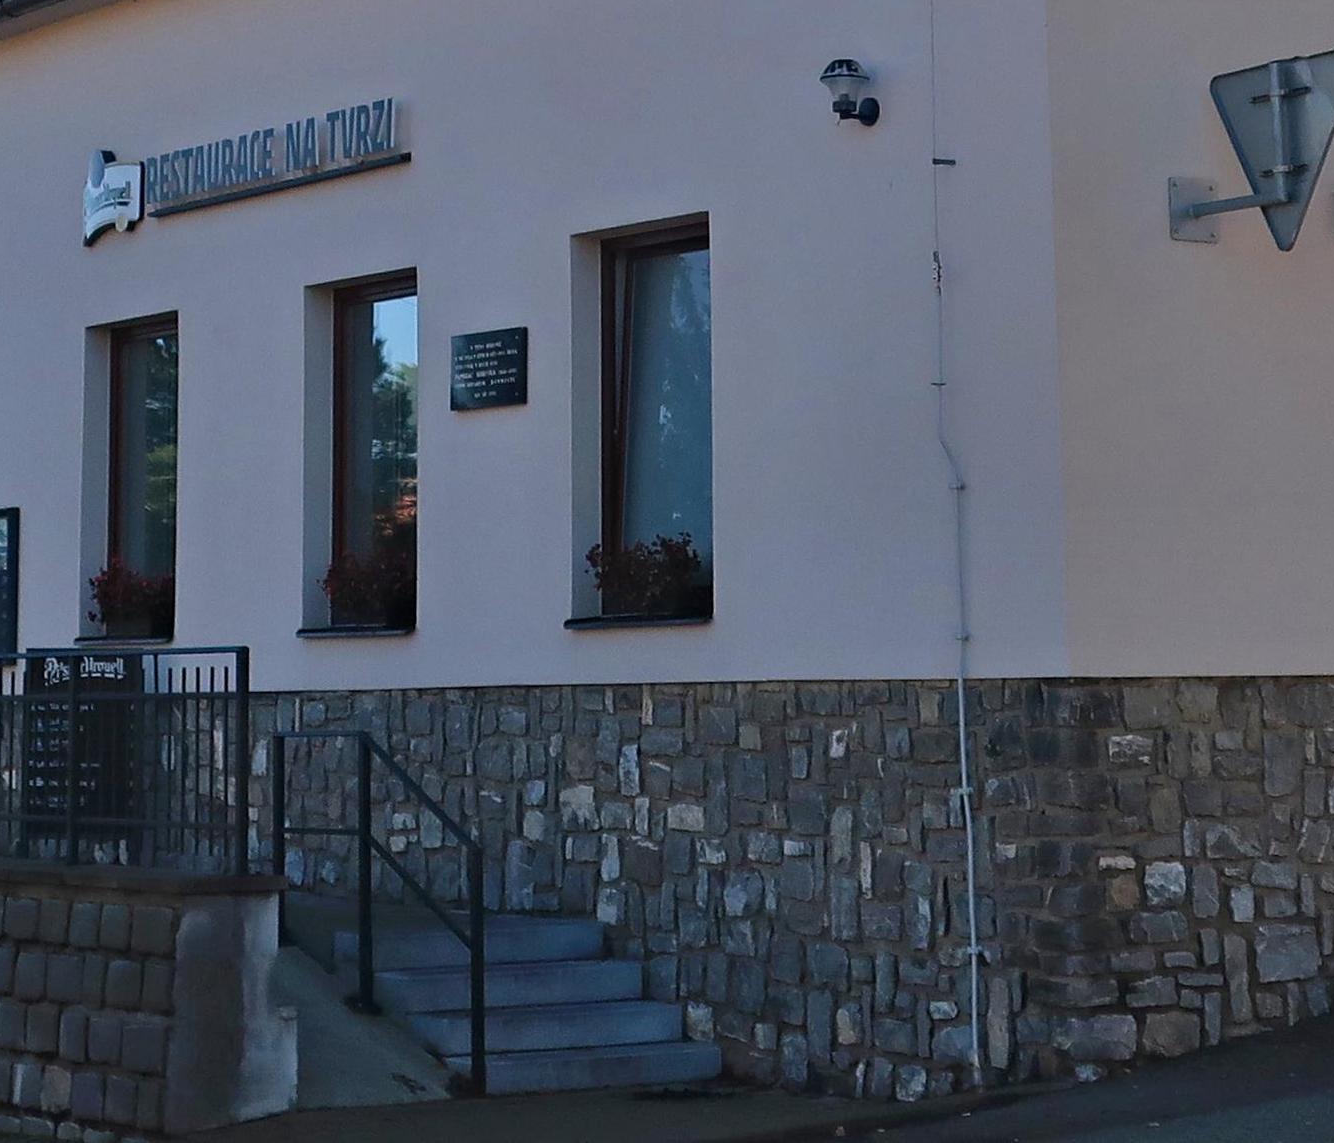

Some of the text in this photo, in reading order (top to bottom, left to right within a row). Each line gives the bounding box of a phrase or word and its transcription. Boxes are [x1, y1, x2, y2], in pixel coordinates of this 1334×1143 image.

[145, 128, 276, 204] RESTAURACE
[285, 117, 318, 173] NA
[326, 97, 396, 162] TVRZI
